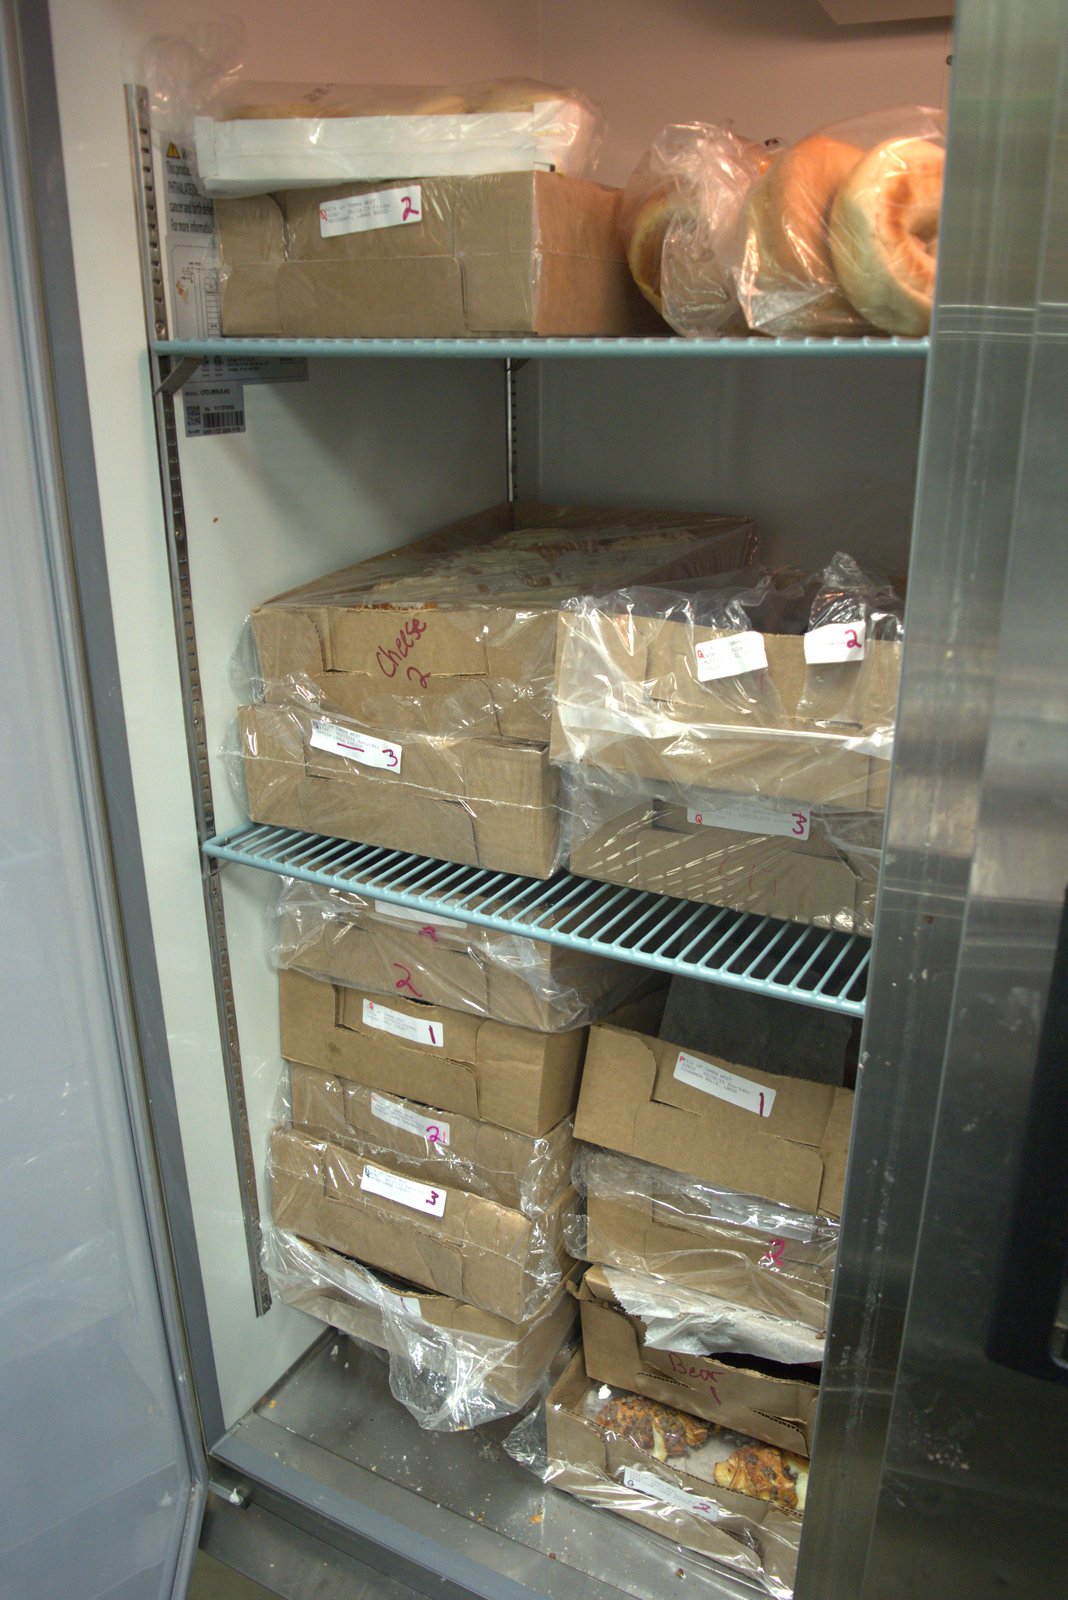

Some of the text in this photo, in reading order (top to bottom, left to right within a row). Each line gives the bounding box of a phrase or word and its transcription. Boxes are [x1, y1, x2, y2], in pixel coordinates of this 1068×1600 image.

[400, 196, 419, 221] 2
[376, 618, 427, 678] Cheese
[844, 629, 863, 649] 2
[406, 666, 432, 689] 2
[382, 749, 399, 767] 3
[393, 963, 422, 998] 2
[428, 1024, 436, 1045] 1
[759, 1091, 765, 1118] 1
[426, 1125, 443, 1143] 2
[426, 1190, 440, 1206] 3
[709, 1386, 722, 1405] 1
